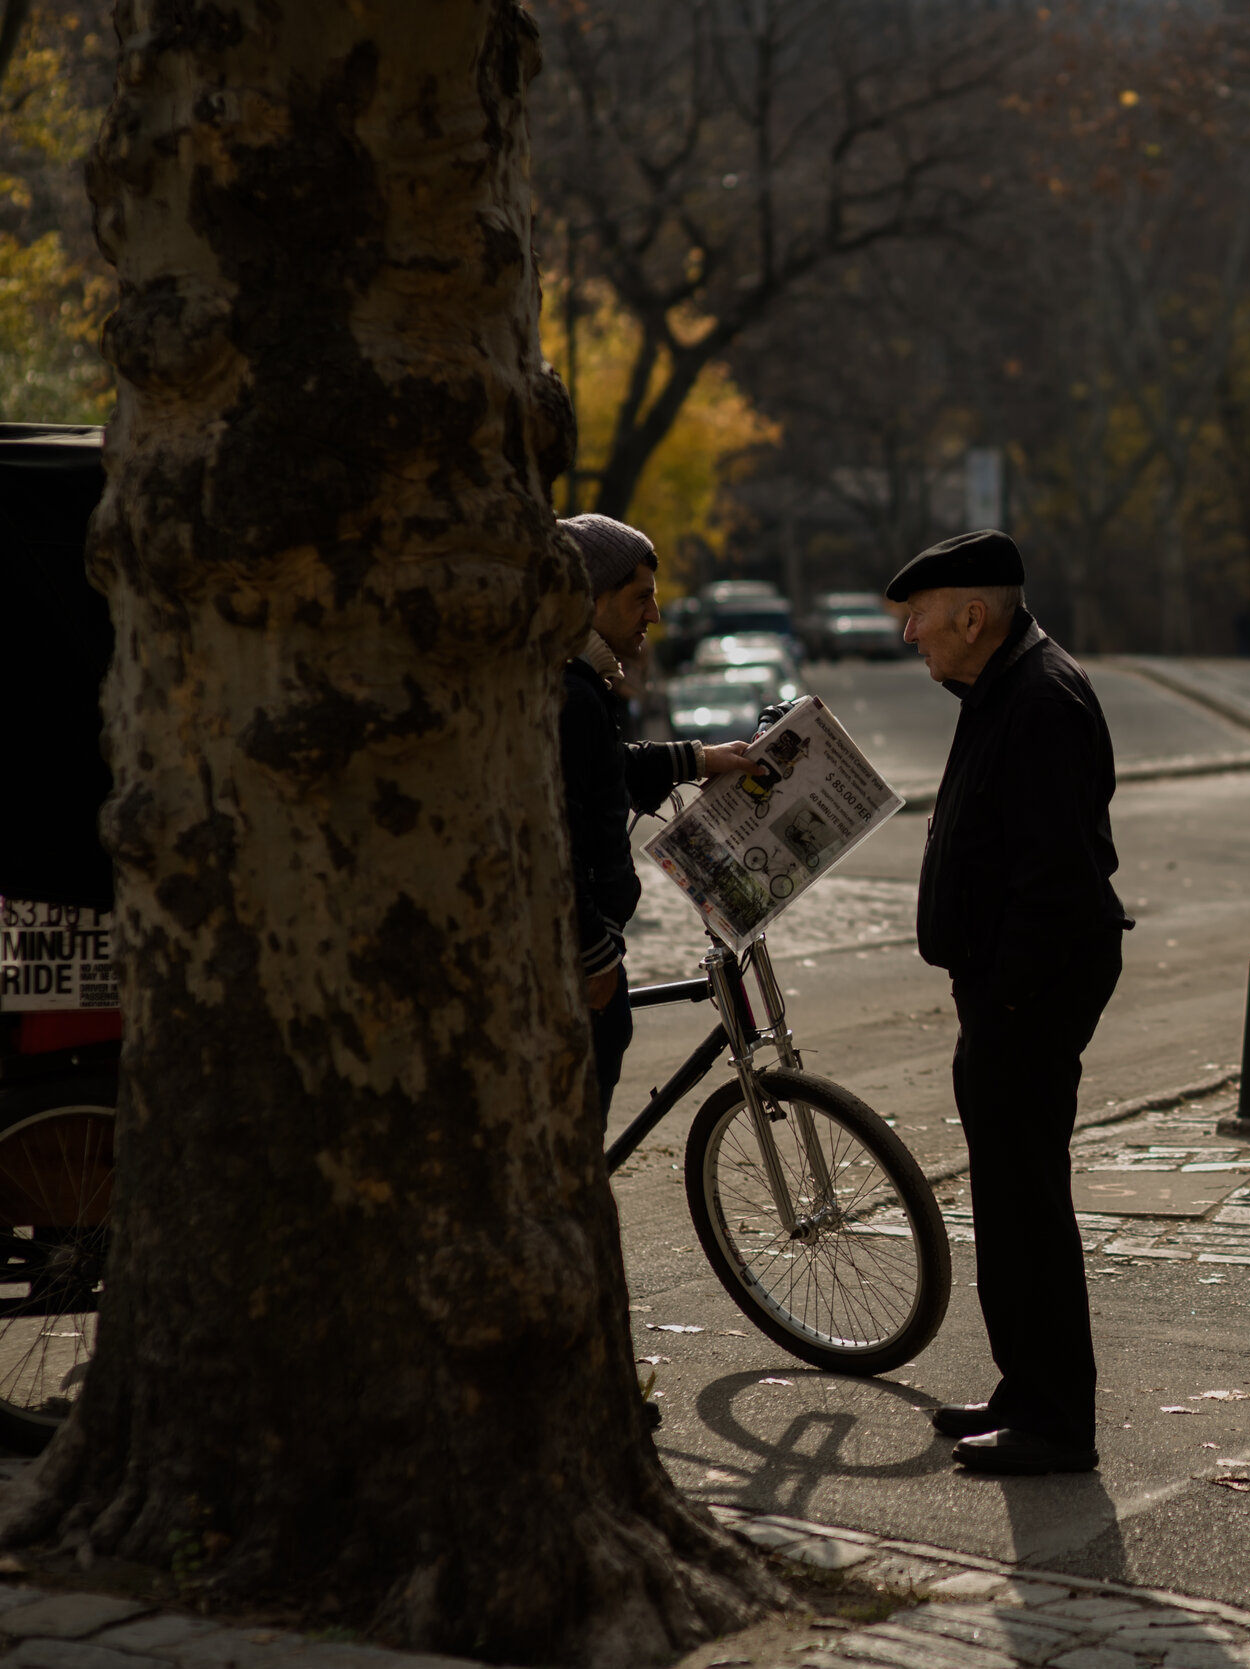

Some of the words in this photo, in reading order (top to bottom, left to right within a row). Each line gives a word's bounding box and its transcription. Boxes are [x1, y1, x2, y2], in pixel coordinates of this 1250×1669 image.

[835, 738, 850, 754] Tours
[852, 757, 872, 779] Central
[870, 777, 884, 791] Park
[808, 791, 819, 802] 60
[815, 798, 840, 825] MINUTE
[831, 777, 857, 806] 85.00
[852, 802, 872, 823] PER
[3, 931, 109, 961] MINUTE
[2, 965, 72, 995] RIDE
